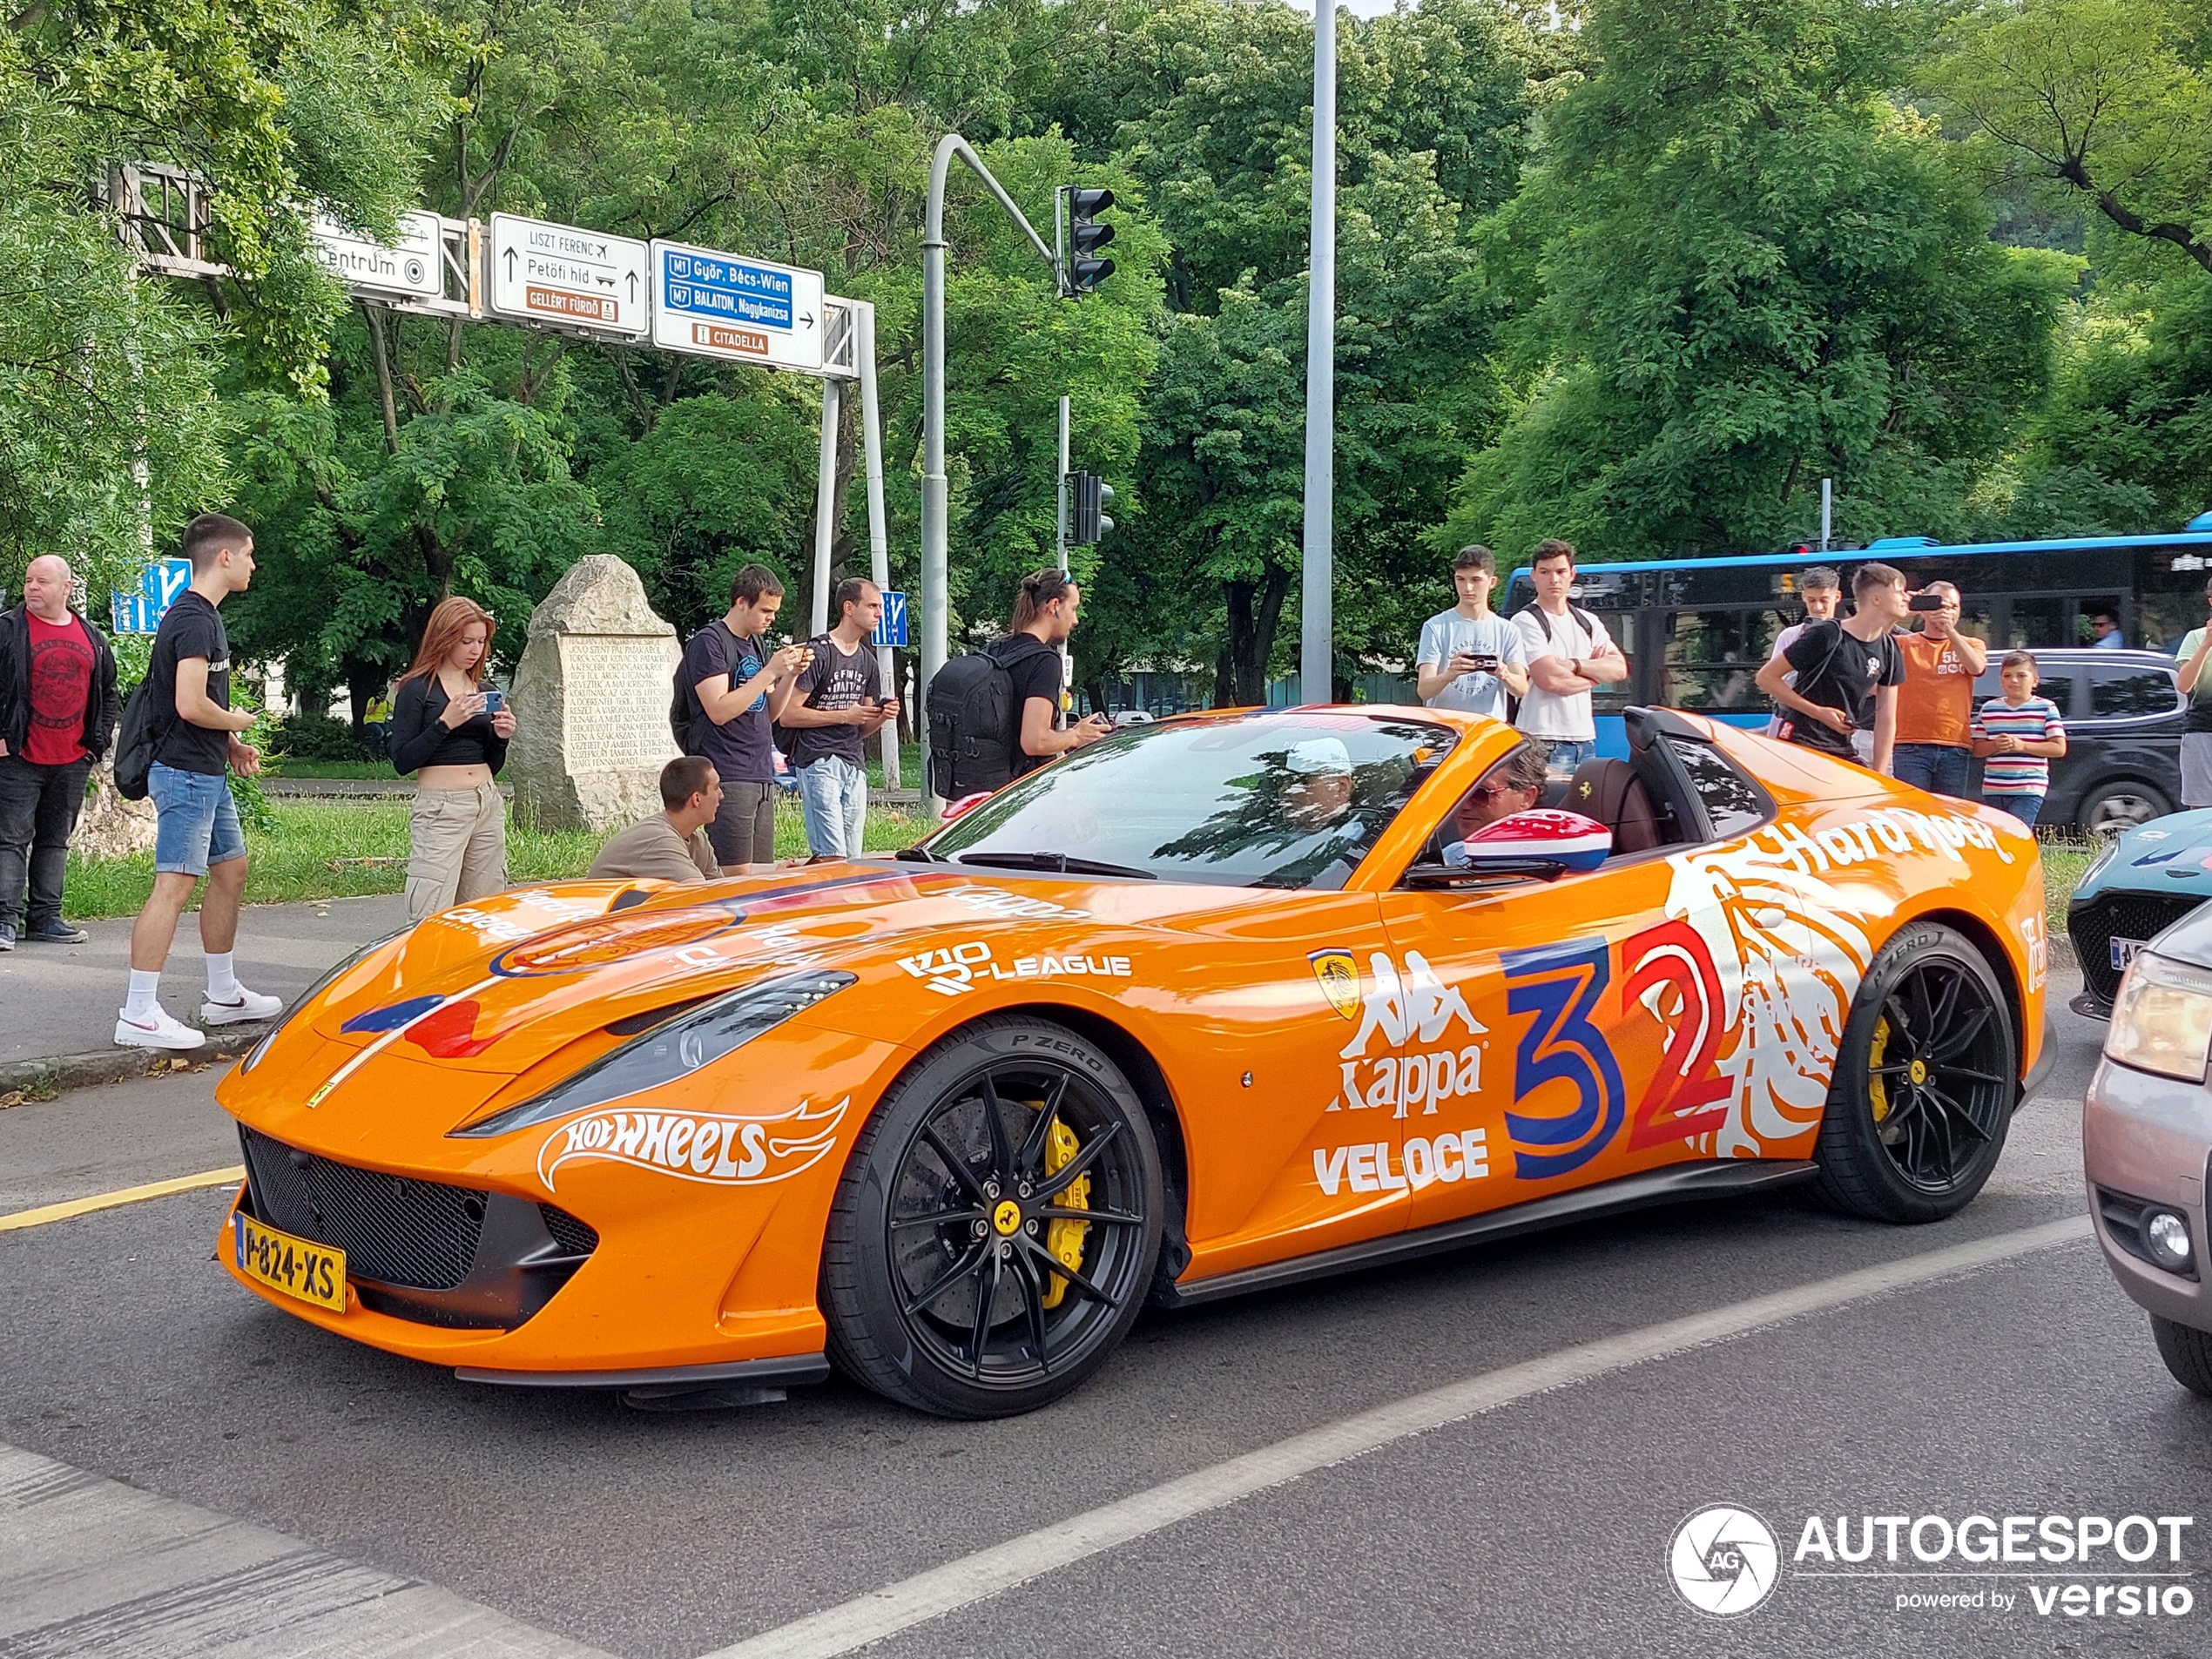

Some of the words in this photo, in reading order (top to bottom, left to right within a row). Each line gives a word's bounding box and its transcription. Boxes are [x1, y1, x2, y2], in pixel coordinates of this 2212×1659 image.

[529, 231, 556, 249] LISZT
[559, 237, 594, 256] FERENC
[673, 260, 686, 274] M1
[729, 267, 789, 293] Bécs-Wien
[673, 288, 686, 304] M7
[694, 289, 738, 314] BALATON,
[738, 298, 789, 321] Nagykanizsa
[713, 330, 765, 351] CITADELLA
[1761, 808, 1914, 875] Hard
[921, 885, 1093, 919] Kappa
[1885, 934, 1929, 972] ZERO
[1011, 1035, 1029, 1046] P
[1035, 1036, 1103, 1072] ZERO
[1498, 920, 1733, 1179] 32
[1325, 1045, 1483, 1119] Kappa
[558, 1118, 616, 1155] HOT
[606, 1114, 766, 1177] WHEELS
[1312, 1128, 1489, 1196] VELOCE
[246, 1227, 334, 1300] P-824-XS
